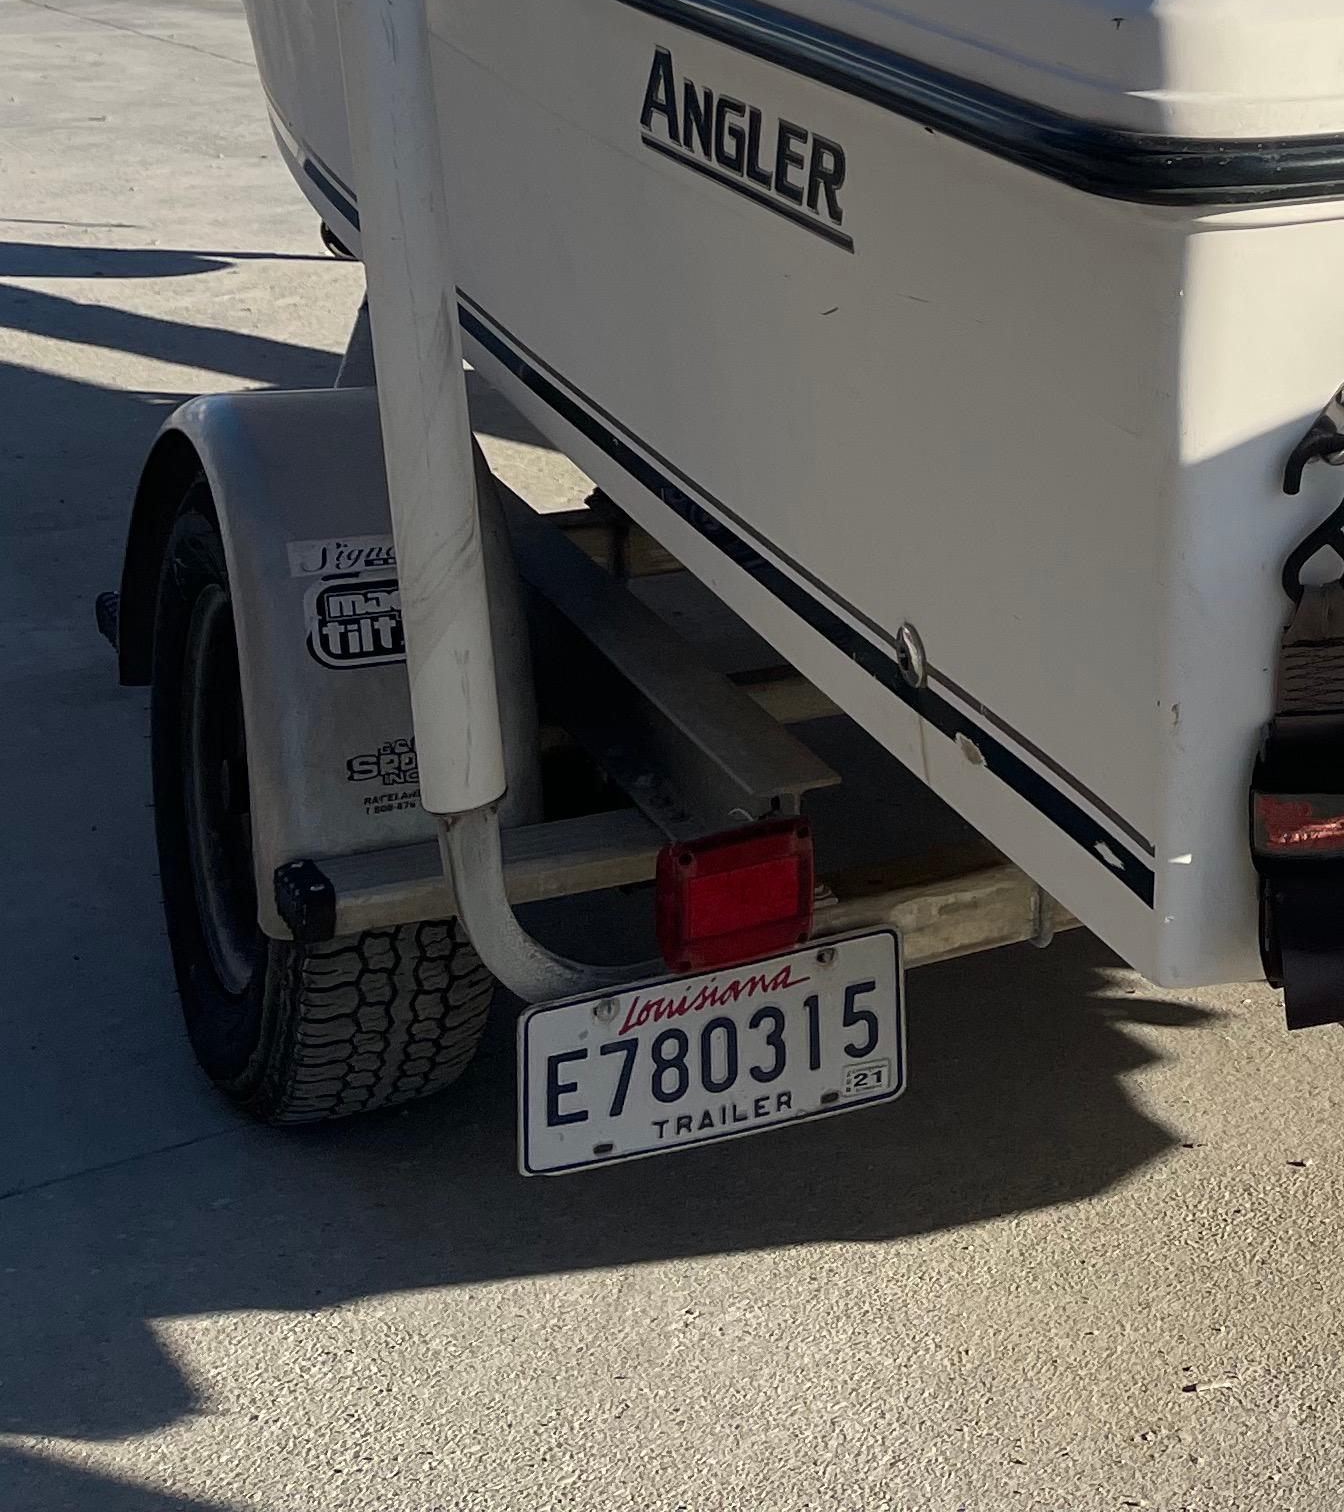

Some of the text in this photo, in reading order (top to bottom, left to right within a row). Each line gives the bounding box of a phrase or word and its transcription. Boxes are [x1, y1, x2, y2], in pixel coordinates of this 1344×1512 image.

[640, 43, 846, 226] ANGLER
[618, 965, 811, 1036] Louisiana
[546, 979, 879, 1127] E780315
[854, 1070, 882, 1088] 21
[651, 1091, 793, 1140] TRAILER
